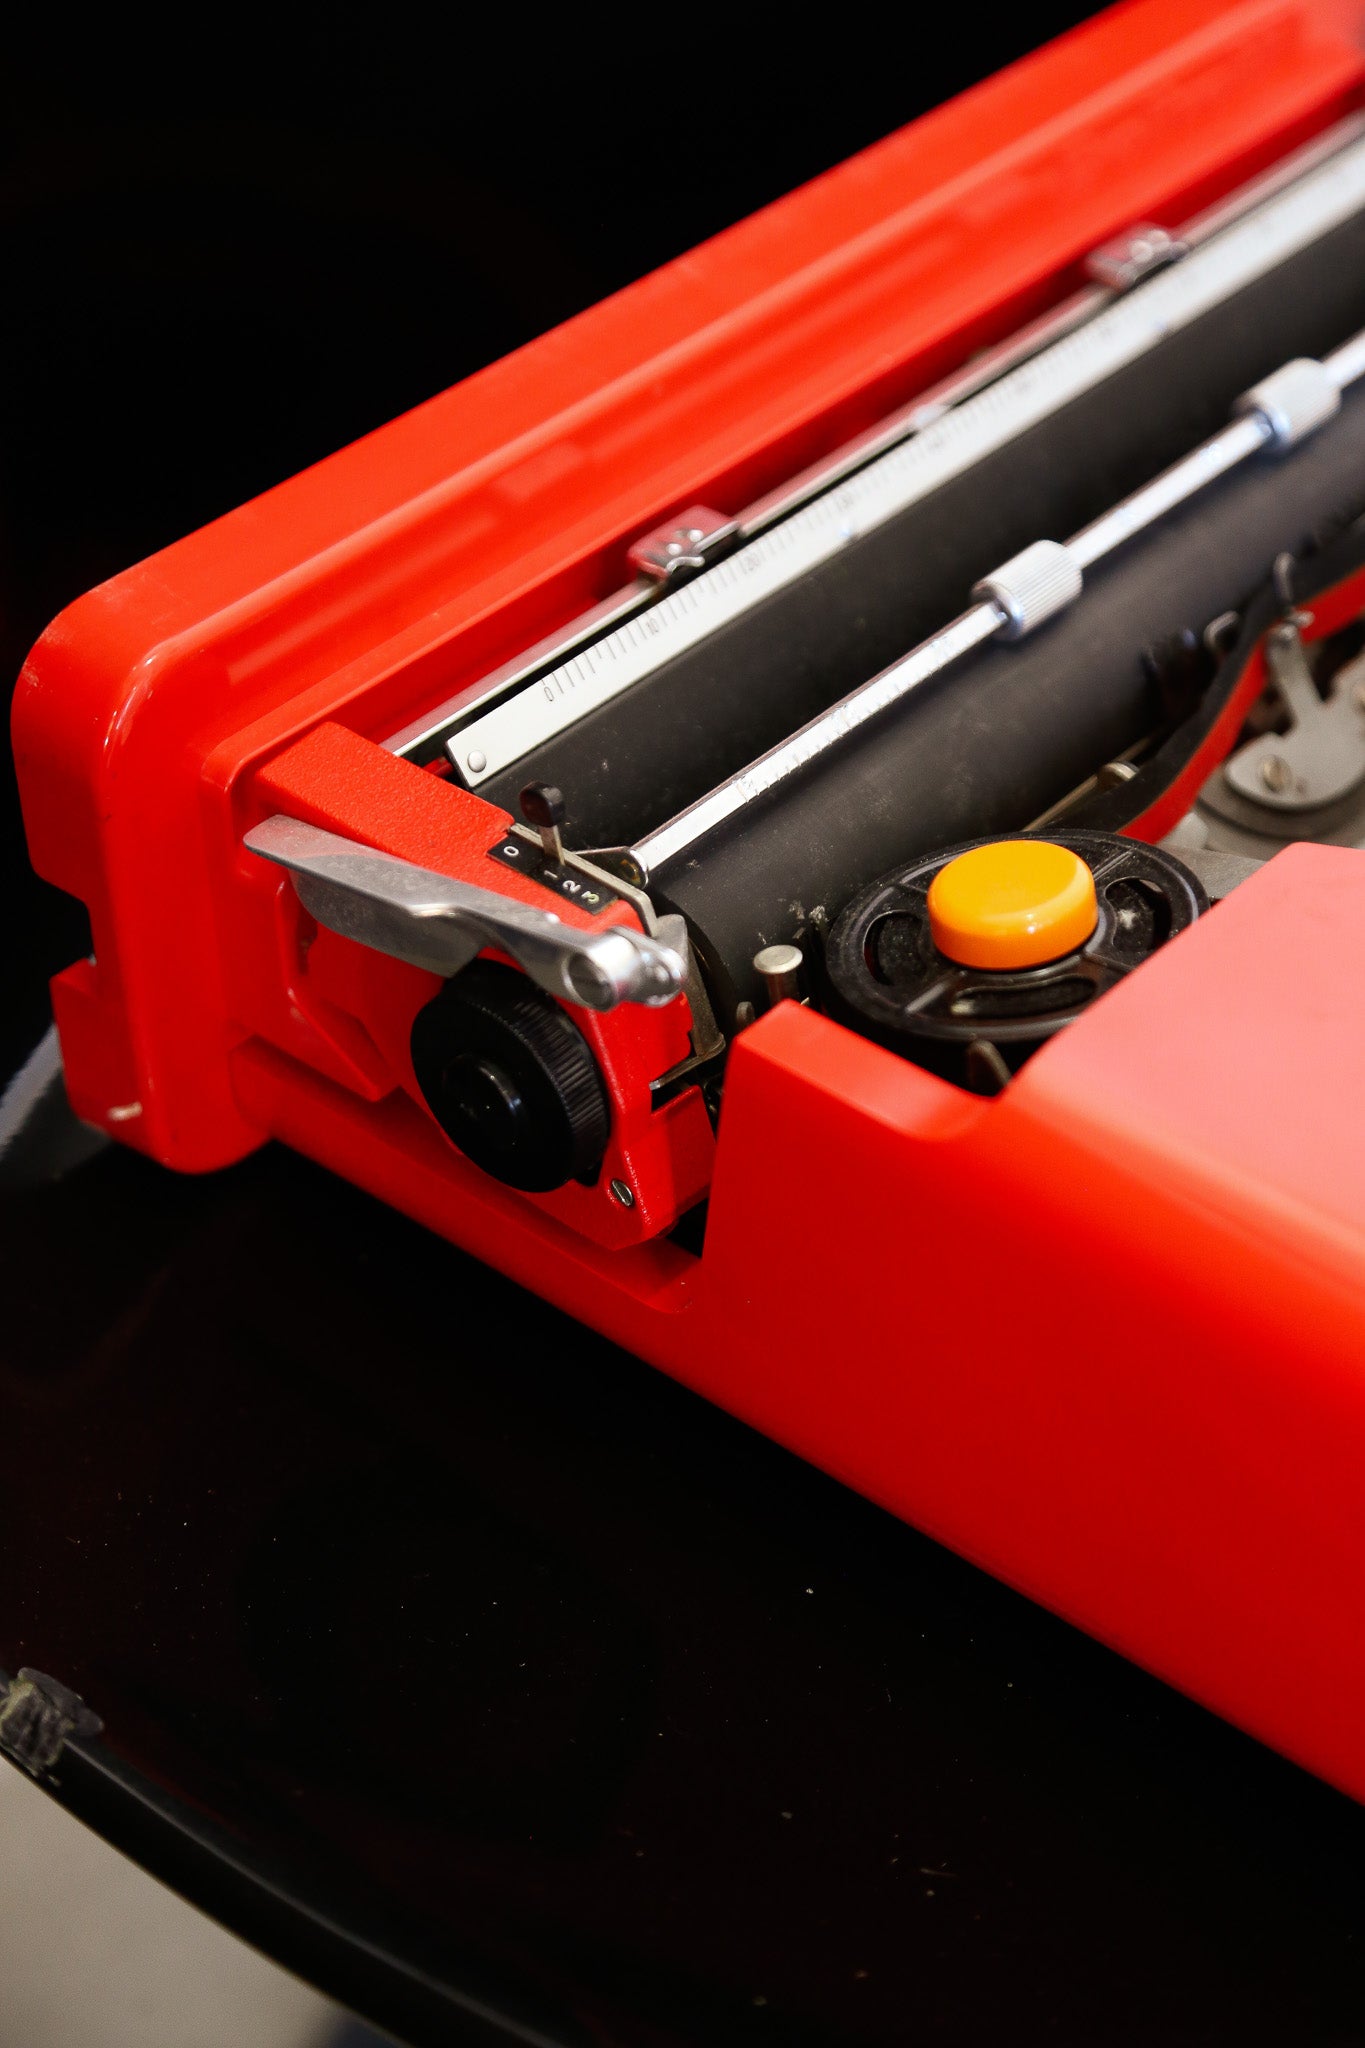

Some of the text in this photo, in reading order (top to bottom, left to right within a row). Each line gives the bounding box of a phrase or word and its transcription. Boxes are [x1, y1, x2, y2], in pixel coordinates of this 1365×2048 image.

[544, 686, 554, 702] 0
[503, 845, 600, 904] 0 1 2 3
